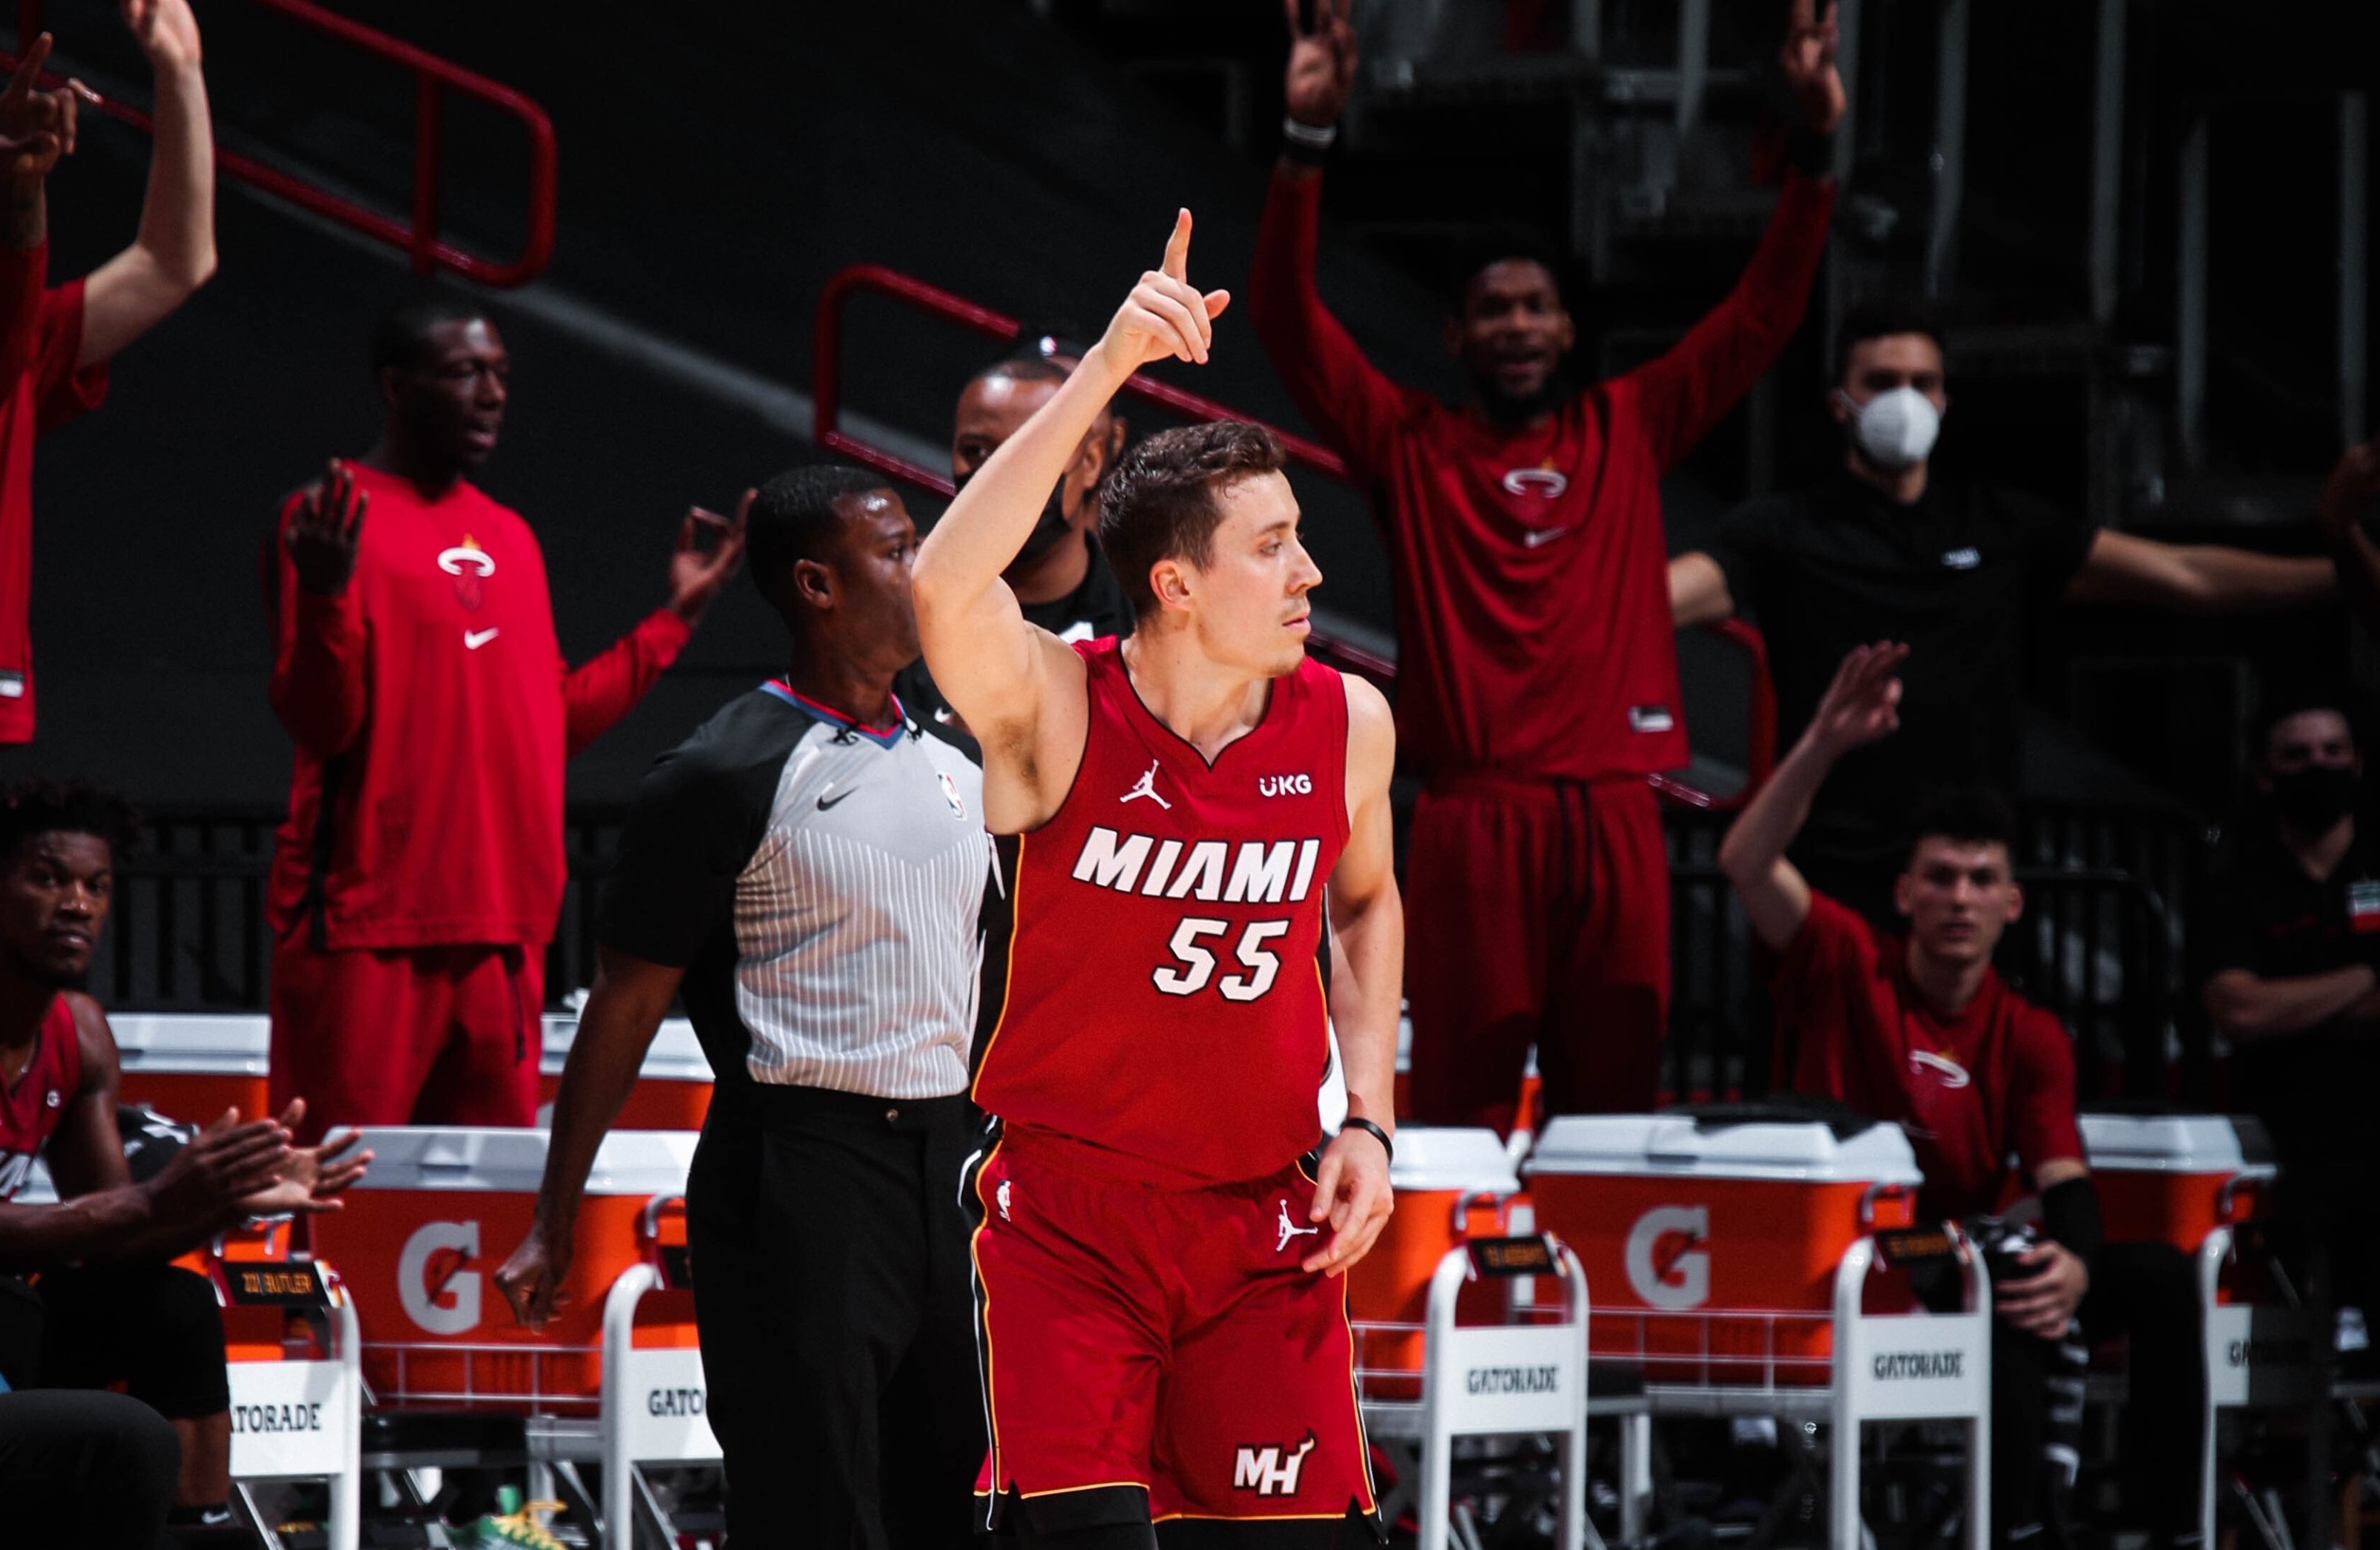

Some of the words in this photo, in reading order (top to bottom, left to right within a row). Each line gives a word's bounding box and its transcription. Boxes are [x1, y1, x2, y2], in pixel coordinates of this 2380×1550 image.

[1071, 825, 1321, 904] MIAMI
[1151, 916, 1291, 1002] 55
[398, 1220, 482, 1335] G
[1624, 1205, 1711, 1310] G
[1874, 1352, 1963, 1379] GATORADE
[232, 1404, 321, 1433] TORADE
[648, 1389, 706, 1416] GATO
[1232, 1435, 1318, 1497] MH
